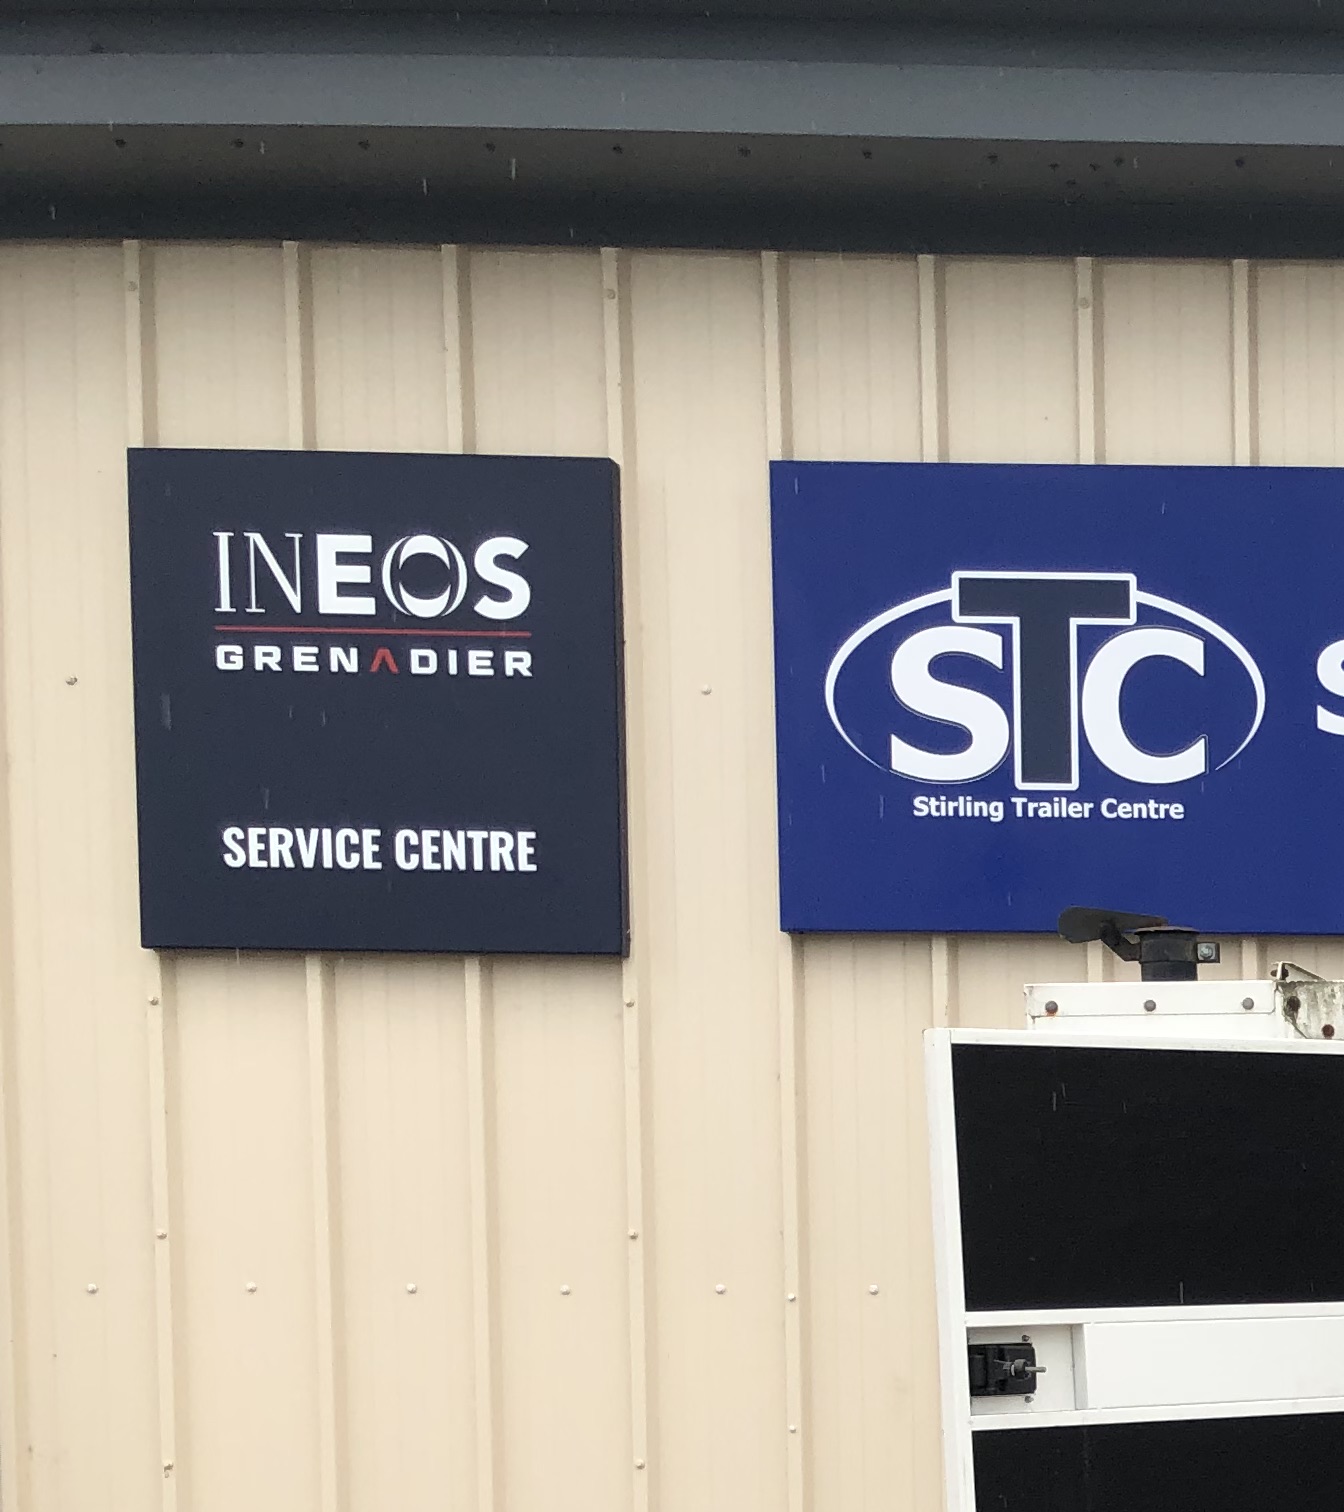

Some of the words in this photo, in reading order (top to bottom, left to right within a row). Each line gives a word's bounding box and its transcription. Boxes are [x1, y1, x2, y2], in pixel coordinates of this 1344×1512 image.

[213, 531, 532, 620] INEOS
[215, 644, 533, 677] GRENADIER
[890, 571, 1206, 791] STC
[912, 795, 1004, 822] Stirling
[1010, 797, 1094, 819] Trailer
[1100, 798, 1185, 820] Centre
[222, 826, 383, 869] SERVICE
[394, 828, 538, 872] CENTRE
